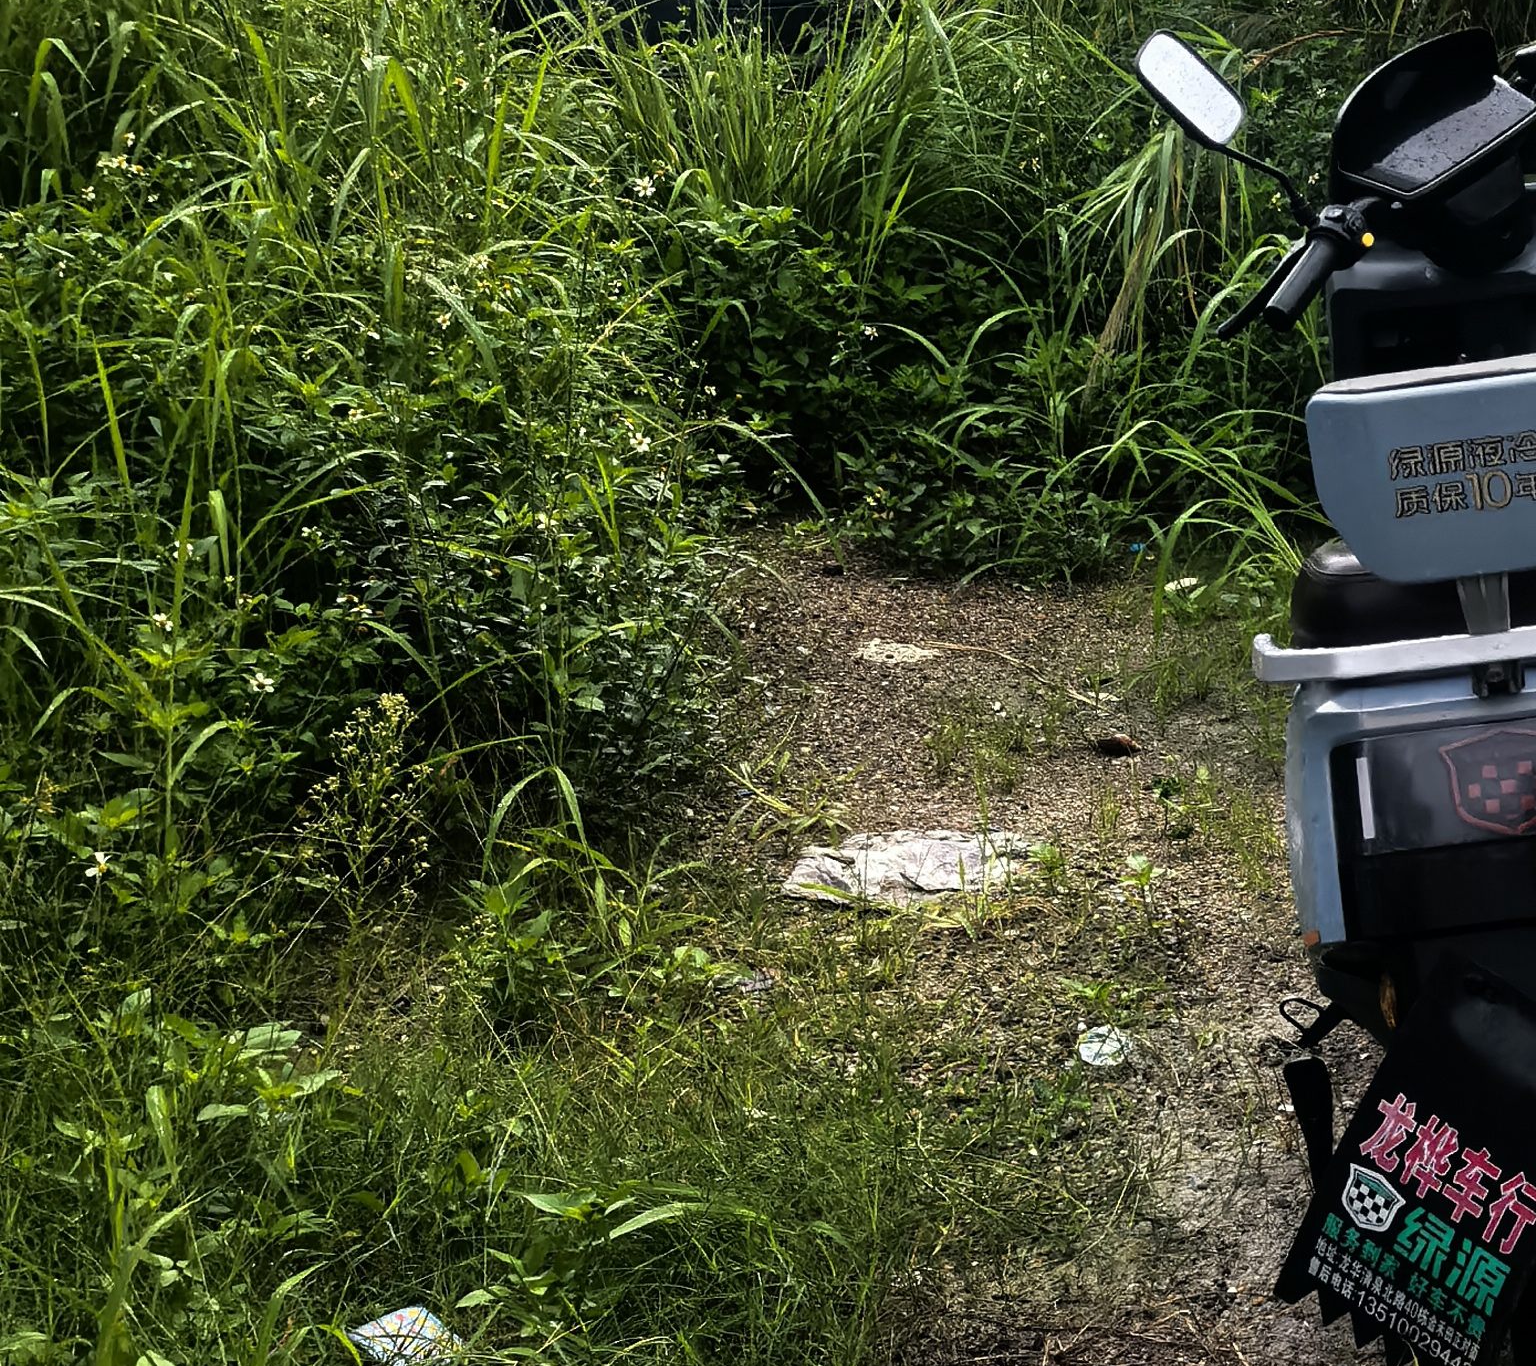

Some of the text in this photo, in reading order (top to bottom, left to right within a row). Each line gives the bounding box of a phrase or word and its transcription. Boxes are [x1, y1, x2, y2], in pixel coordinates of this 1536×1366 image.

[1321, 1212, 1486, 1340] 服务到家 好车不贵
[1393, 1206, 1511, 1317] 绿源
